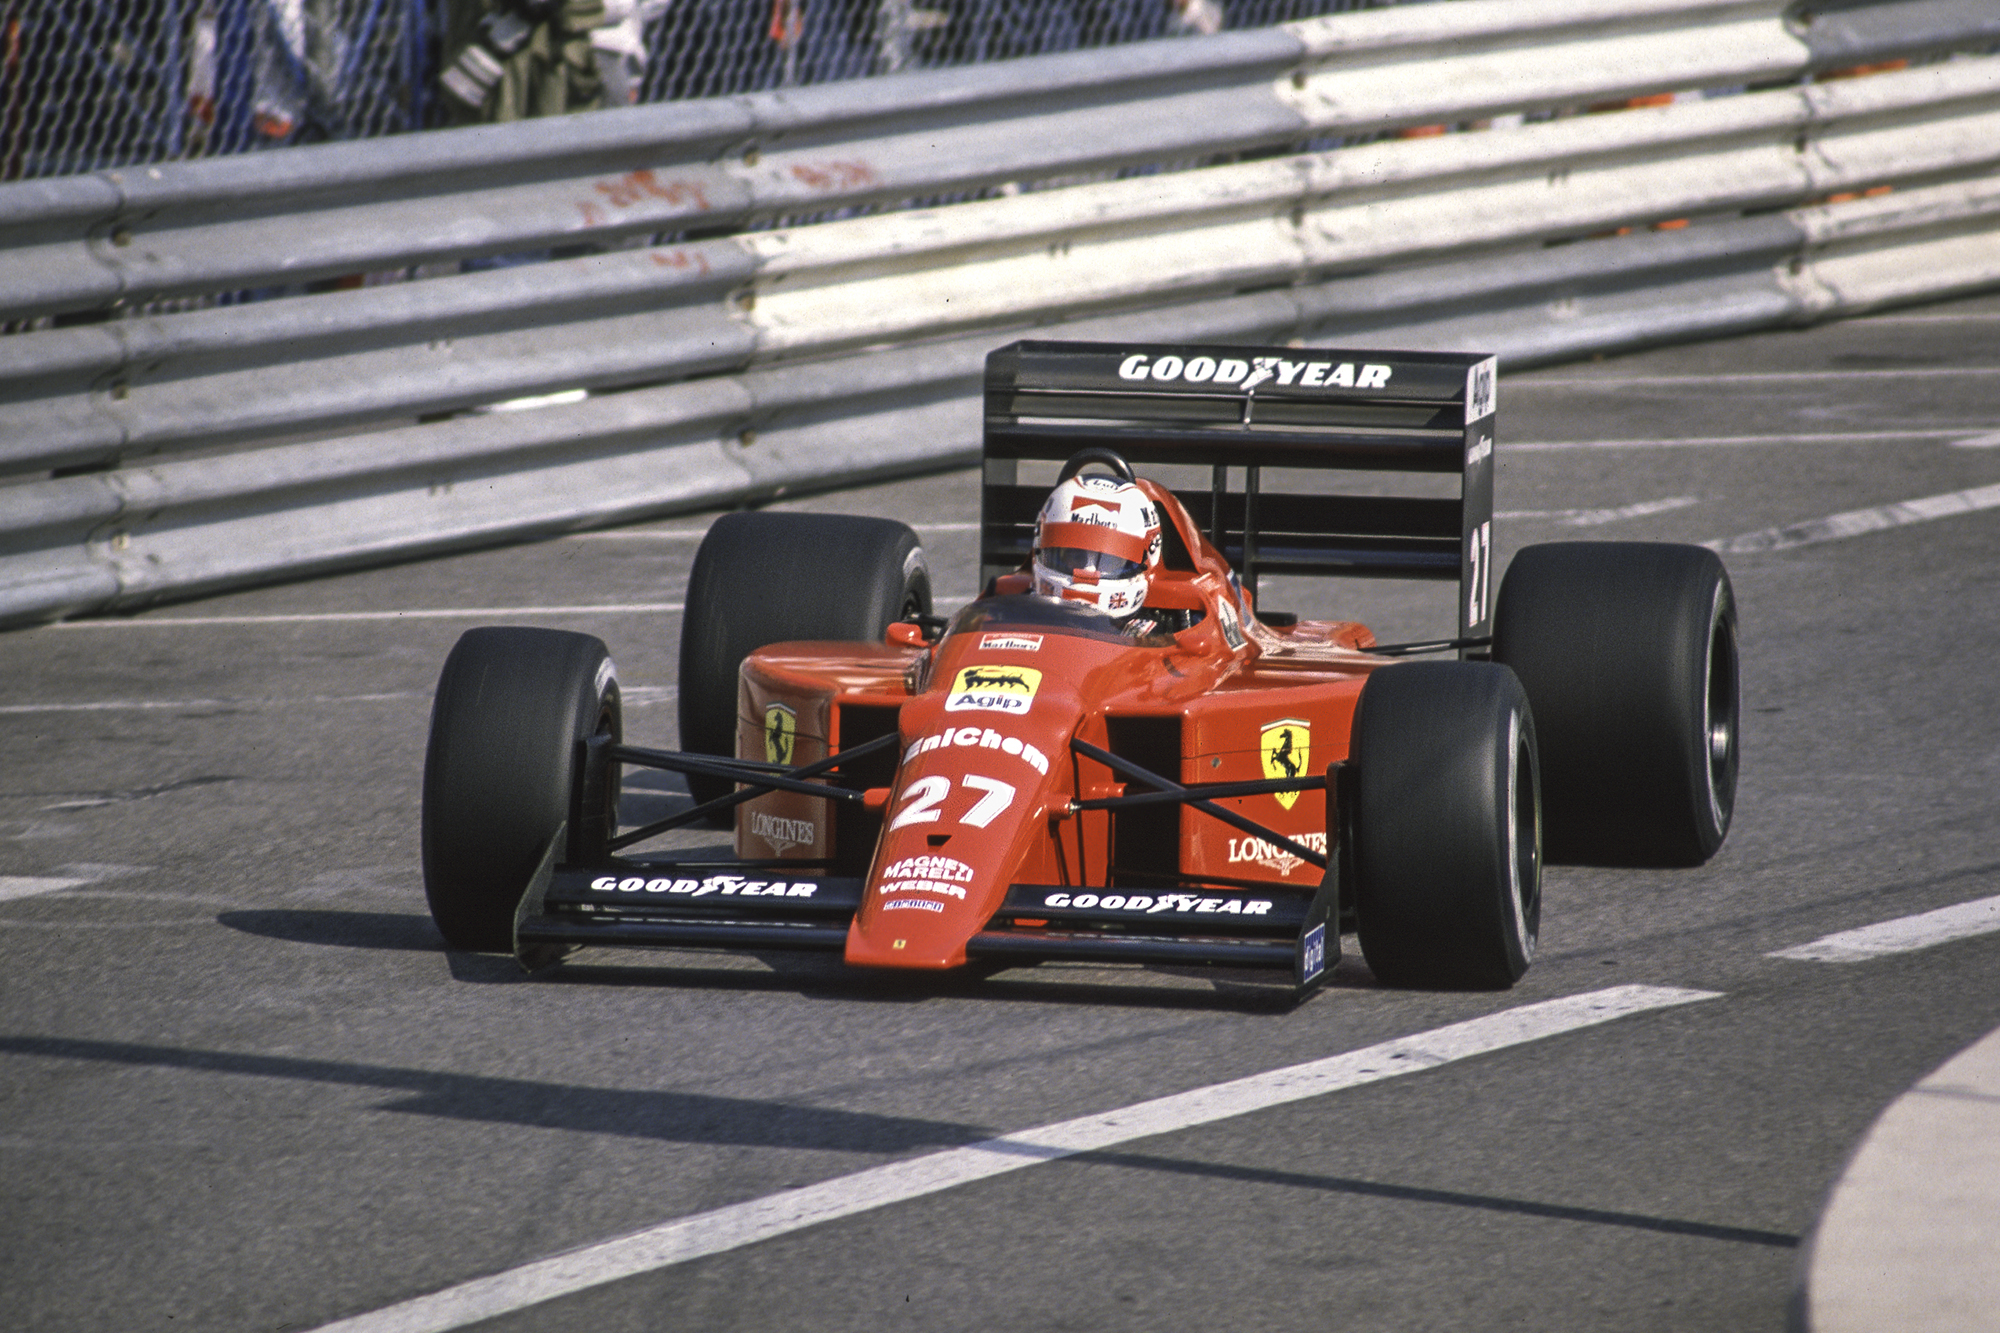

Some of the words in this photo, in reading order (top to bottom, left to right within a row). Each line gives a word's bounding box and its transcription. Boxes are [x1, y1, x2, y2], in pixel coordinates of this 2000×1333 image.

[1119, 354, 1392, 391] GOODYEAR
[1469, 521, 1490, 628] 27
[954, 695, 1022, 709] Agip
[889, 774, 1016, 832] 27
[752, 811, 814, 844] LONGINES
[591, 875, 817, 897] GOODYEAR
[880, 880, 966, 899] WEBER
[1044, 893, 1272, 914] GOODYEAR
